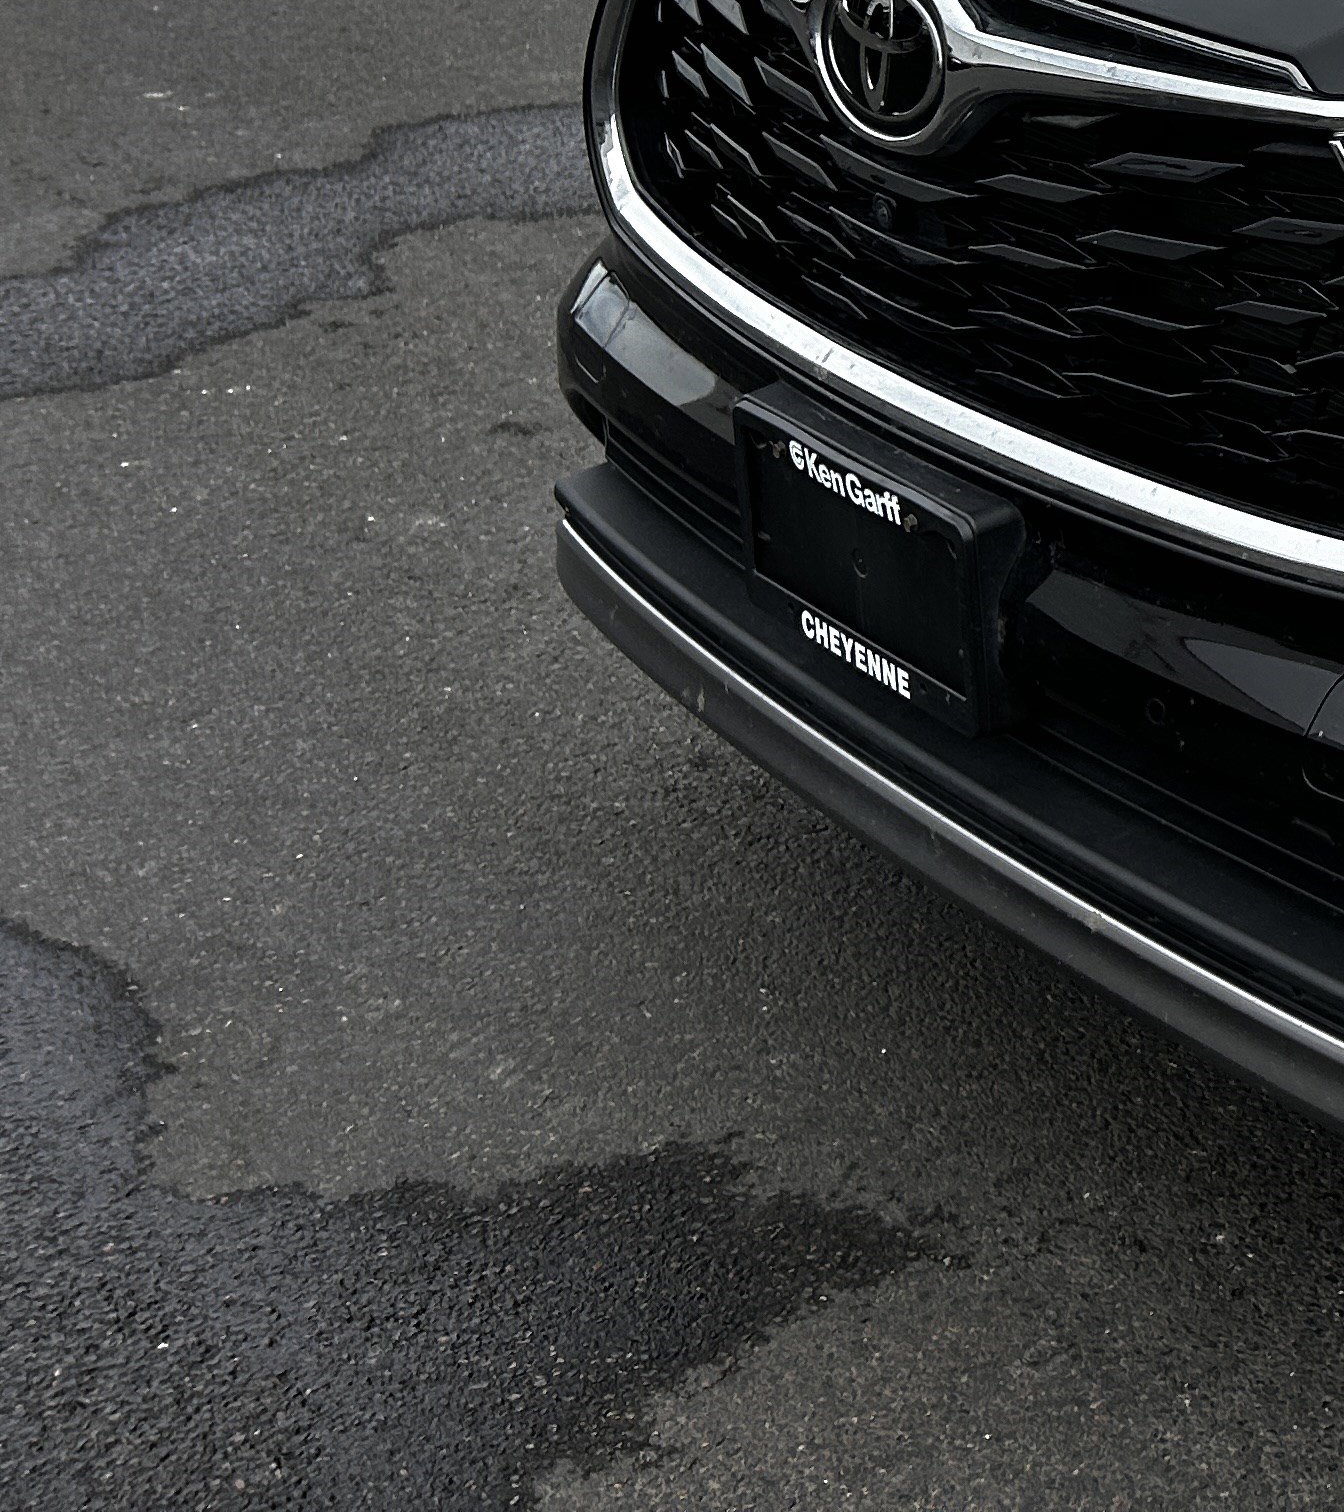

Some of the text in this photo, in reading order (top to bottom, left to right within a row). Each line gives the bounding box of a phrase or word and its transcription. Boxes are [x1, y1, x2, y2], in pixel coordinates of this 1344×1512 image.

[803, 447, 901, 526] Ken Garff
[801, 609, 911, 700] CHEYENNE
